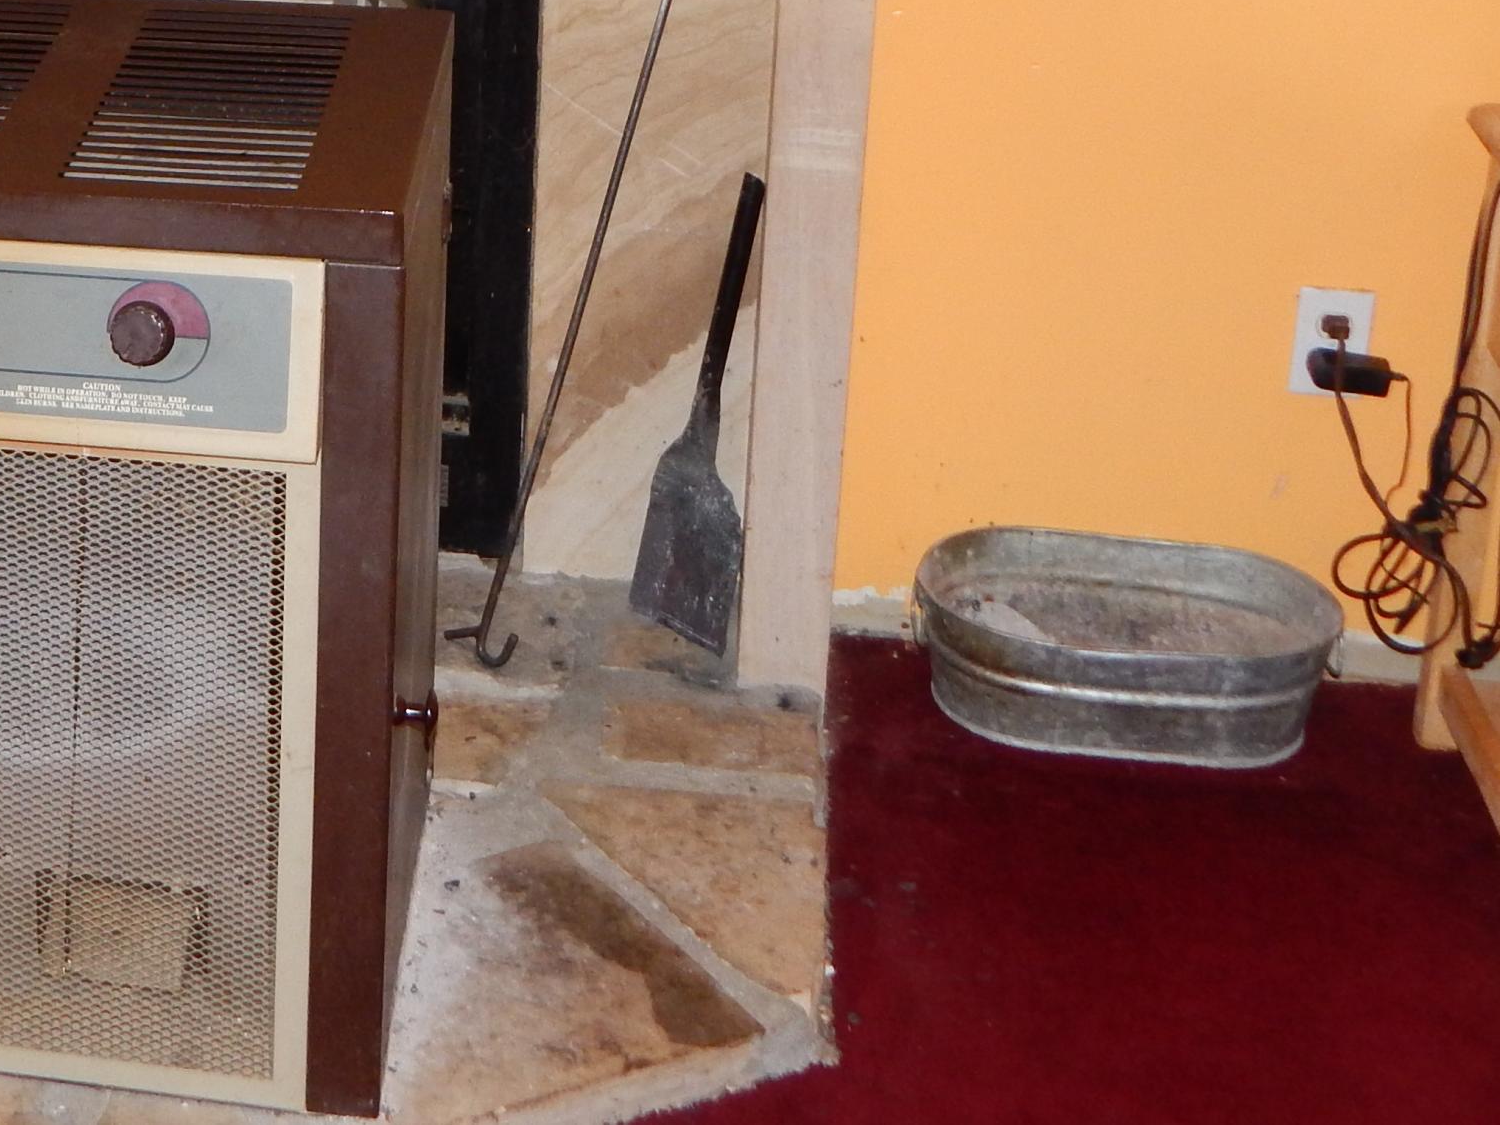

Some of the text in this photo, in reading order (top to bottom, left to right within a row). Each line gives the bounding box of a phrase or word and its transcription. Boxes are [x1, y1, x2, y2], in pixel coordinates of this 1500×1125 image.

[17, 384, 32, 392] HOT
[33, 386, 56, 394] WHILE
[82, 382, 121, 392] CAUTION
[29, 392, 65, 401] CLOTHING
[176, 403, 190, 411] MAY
